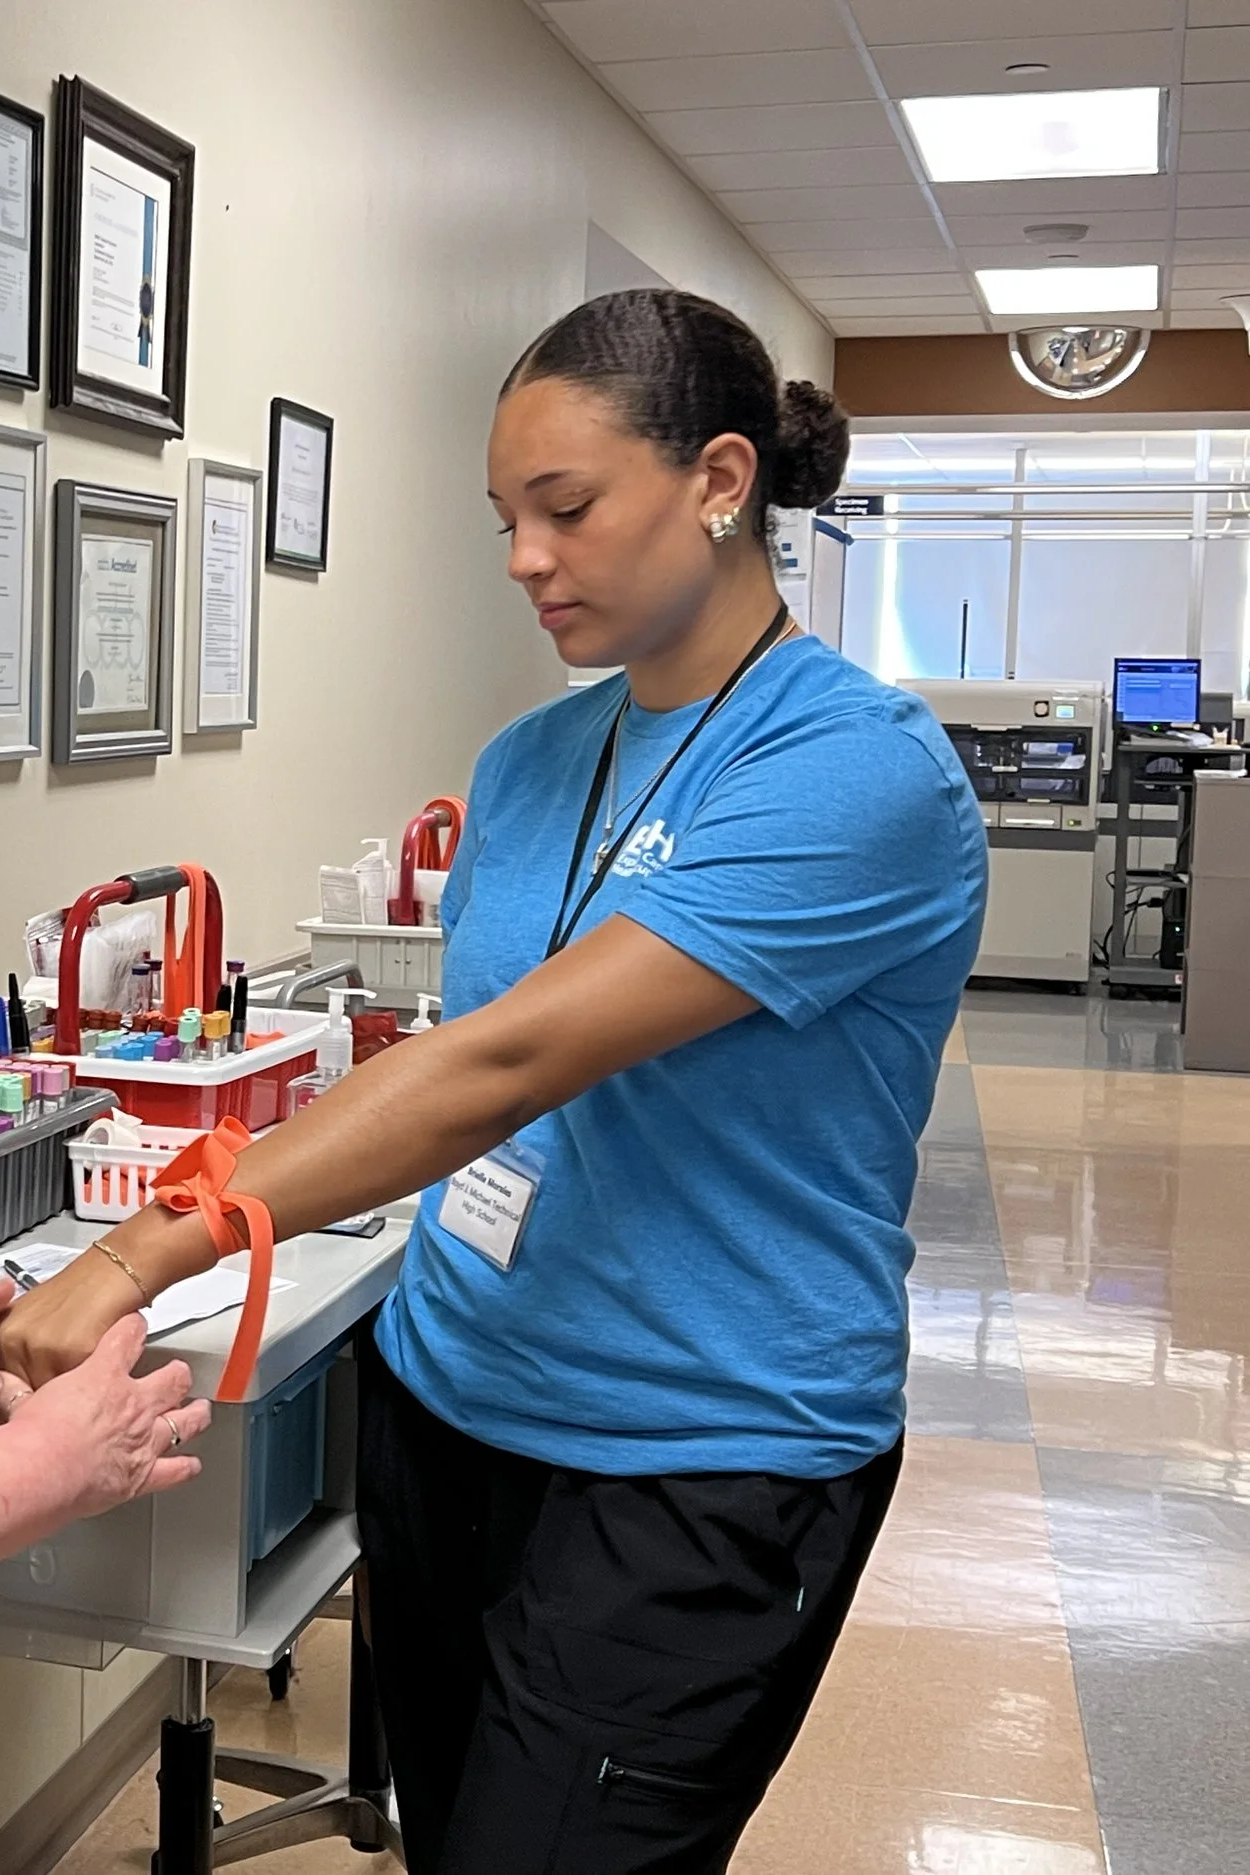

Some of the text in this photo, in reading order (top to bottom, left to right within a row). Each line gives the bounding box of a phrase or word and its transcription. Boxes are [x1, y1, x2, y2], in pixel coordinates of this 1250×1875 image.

[835, 498, 869, 506] Specimen
[834, 506, 868, 515] Receiving
[461, 1199, 497, 1226] High School
[492, 1199, 522, 1222] Technical
